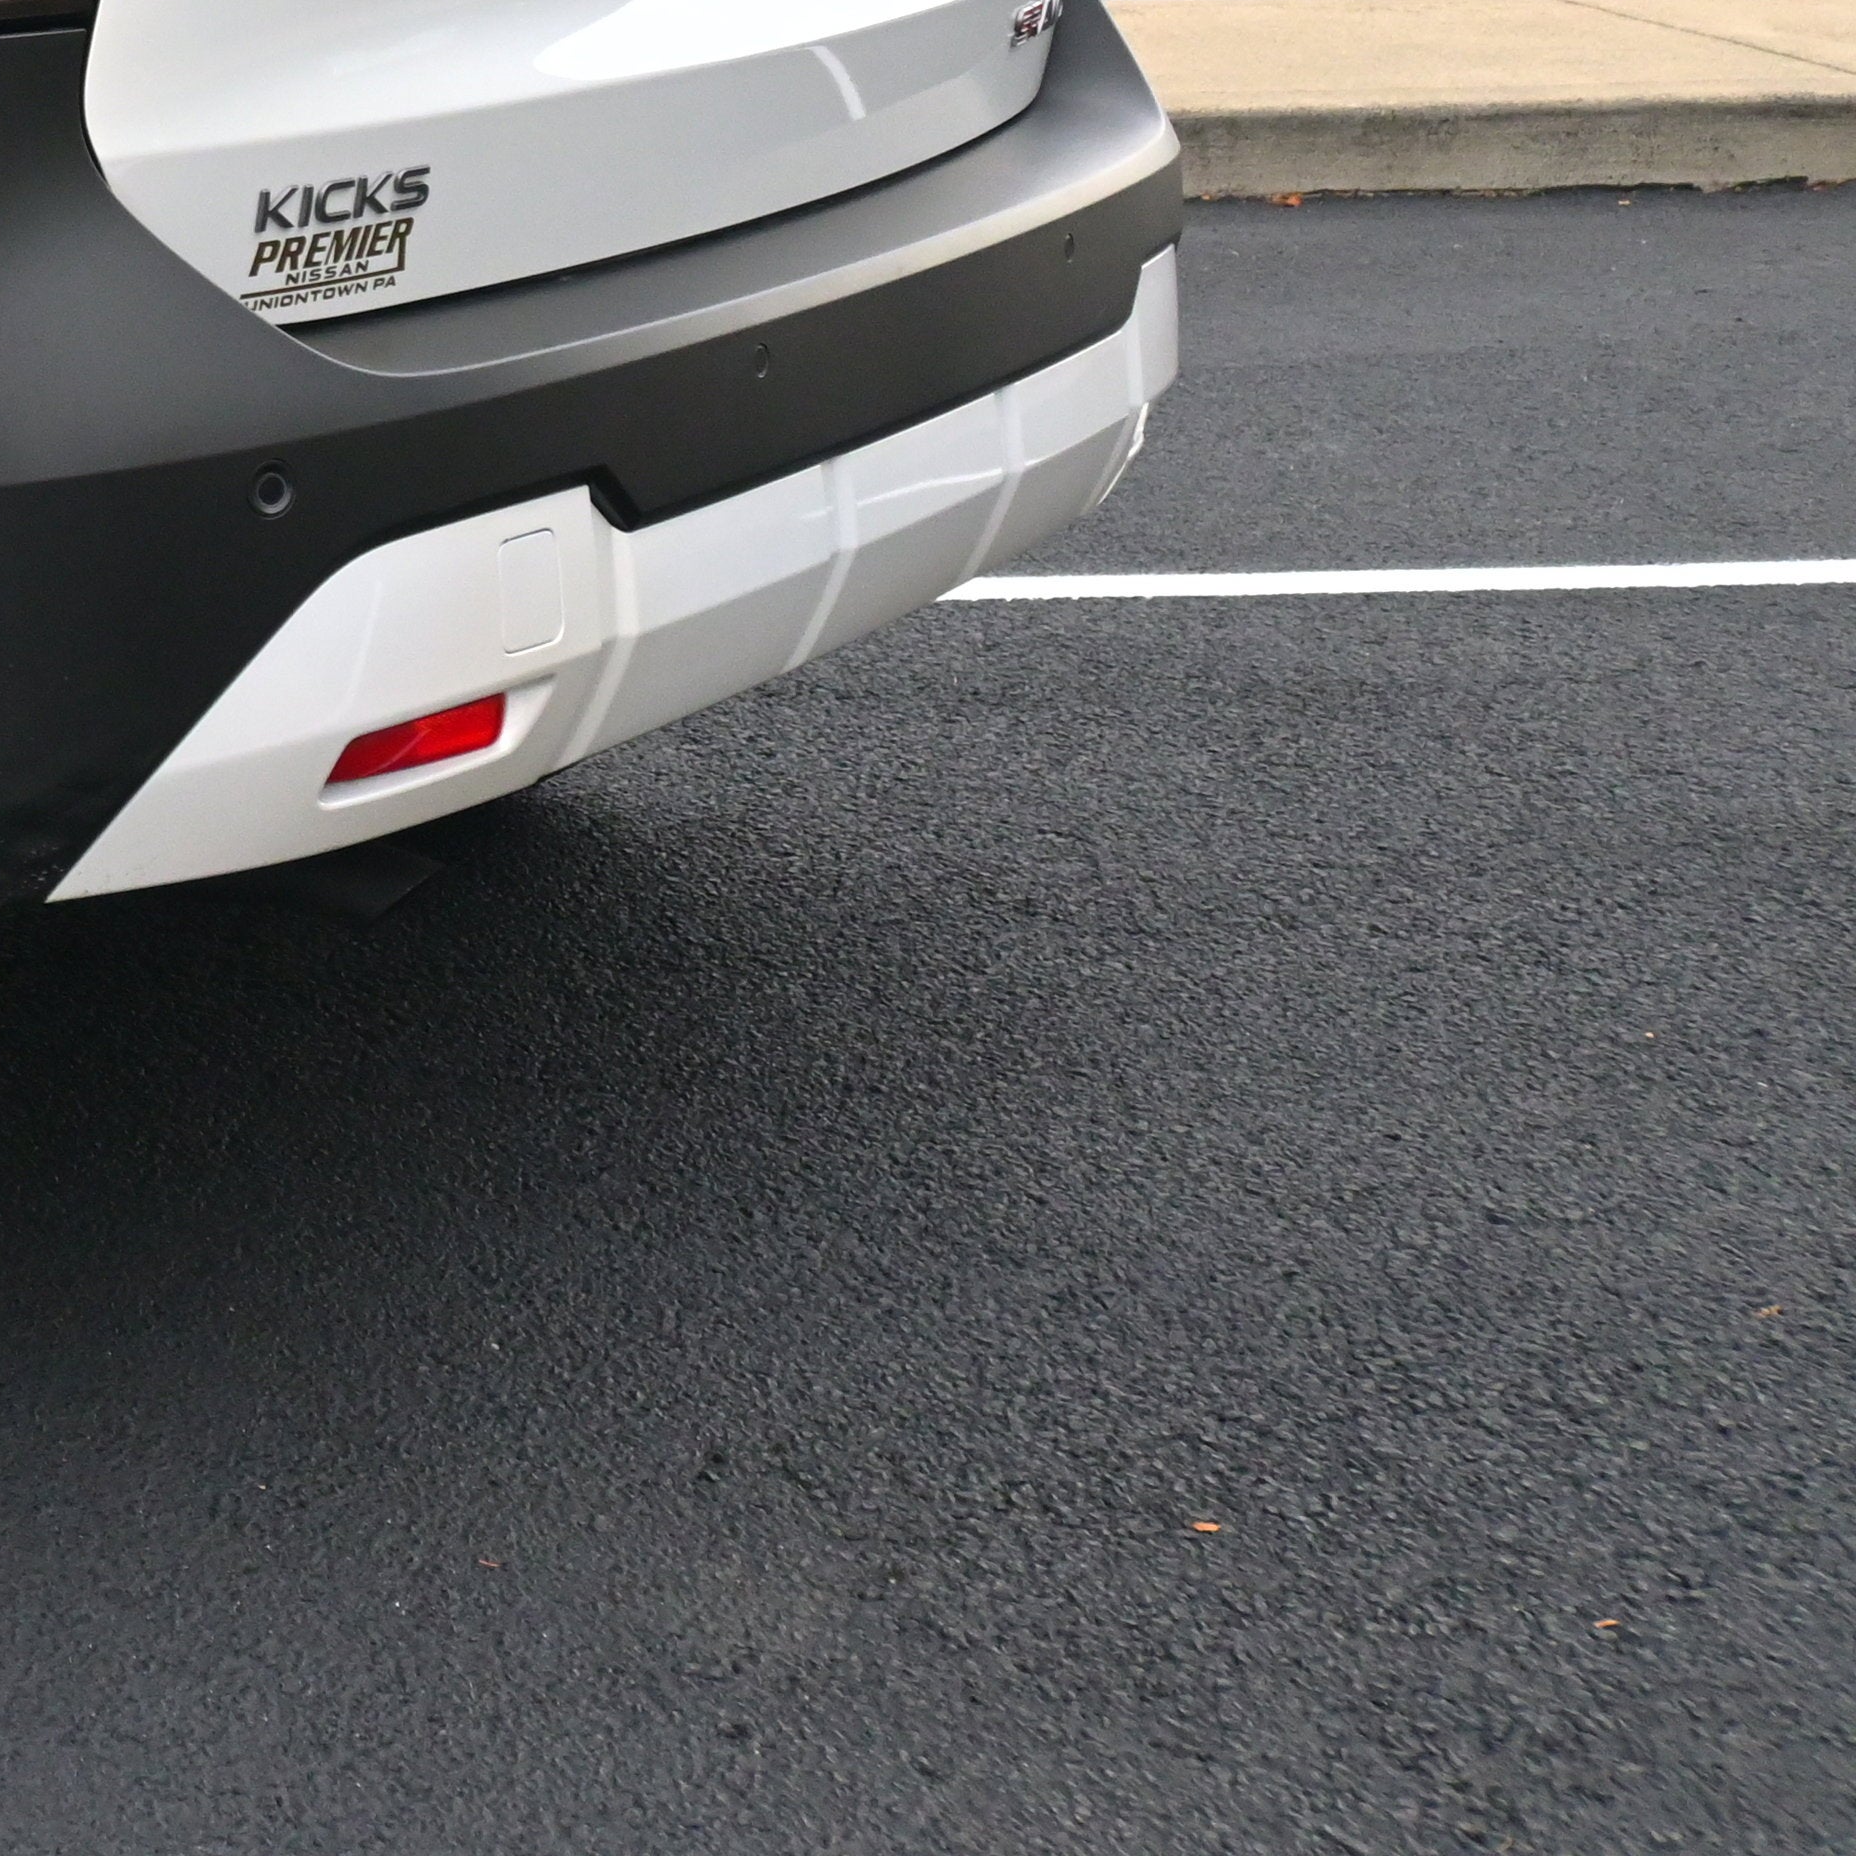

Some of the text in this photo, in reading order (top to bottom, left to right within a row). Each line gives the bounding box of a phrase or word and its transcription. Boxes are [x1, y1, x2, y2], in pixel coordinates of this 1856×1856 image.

[254, 164, 431, 233] KICKS
[248, 217, 414, 277] PREMIER
[244, 275, 396, 312] UNIONTOWN PA
[285, 259, 370, 285] NISSAN
